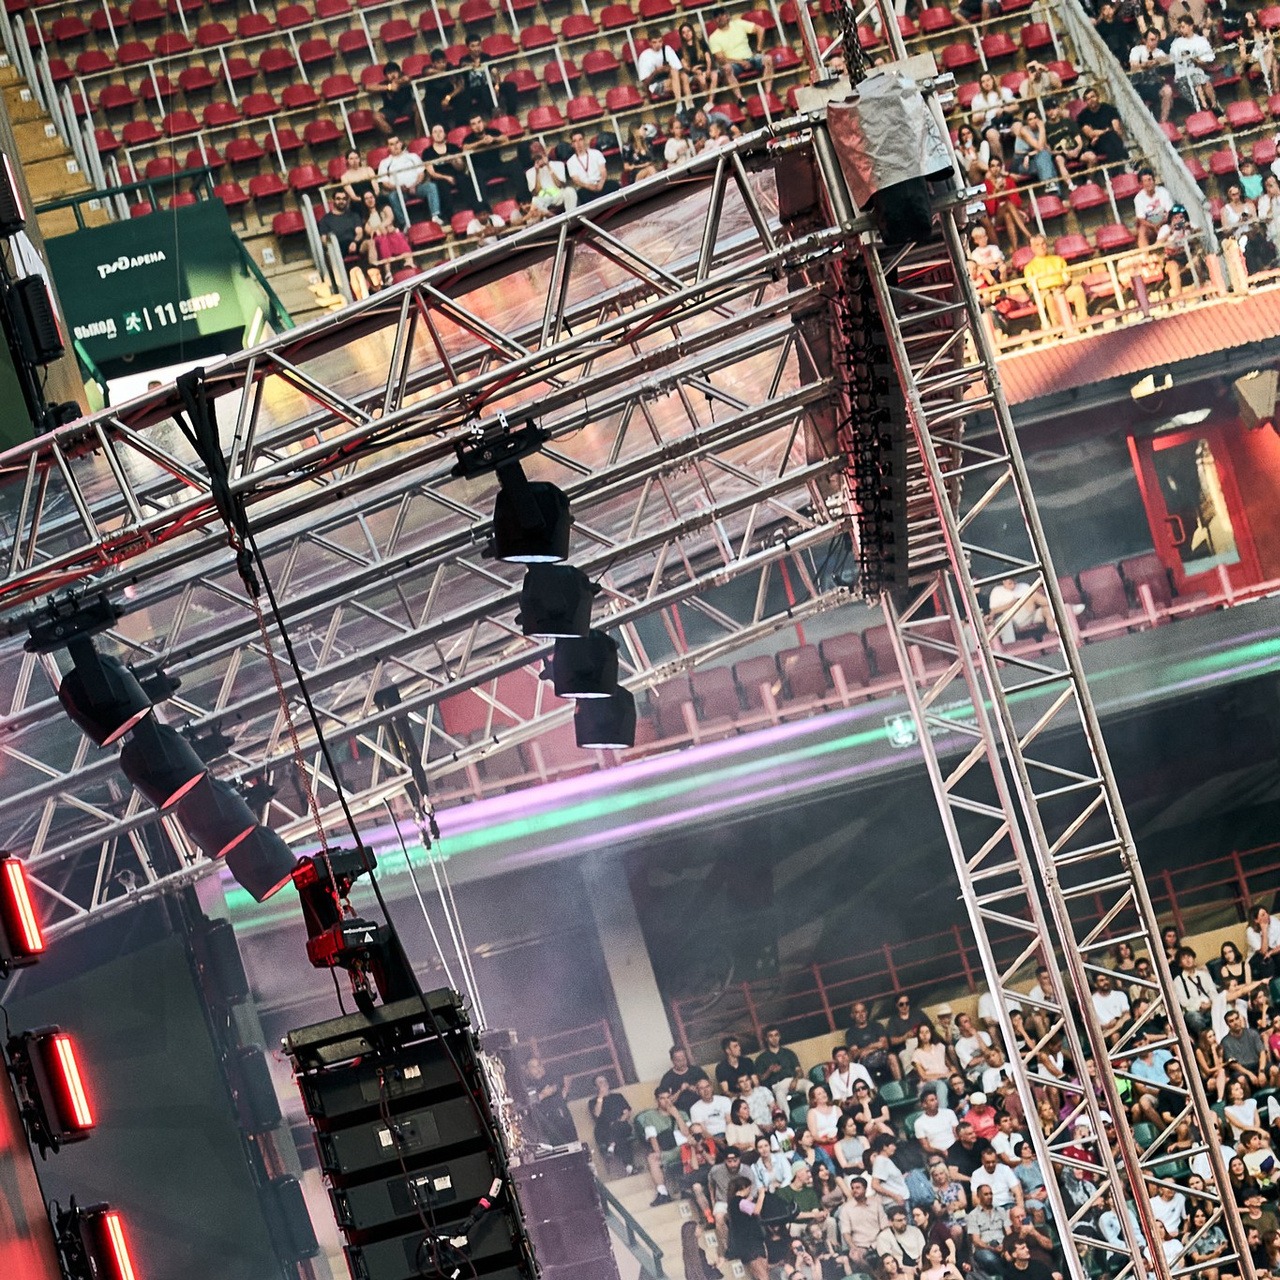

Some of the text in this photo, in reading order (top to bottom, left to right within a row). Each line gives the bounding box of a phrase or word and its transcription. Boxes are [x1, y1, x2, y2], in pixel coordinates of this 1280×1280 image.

[130, 251, 166, 267] АРЕНА
[154, 292, 221, 327] 11 СЕКТОР
[74, 318, 117, 340] ВЫХОД
